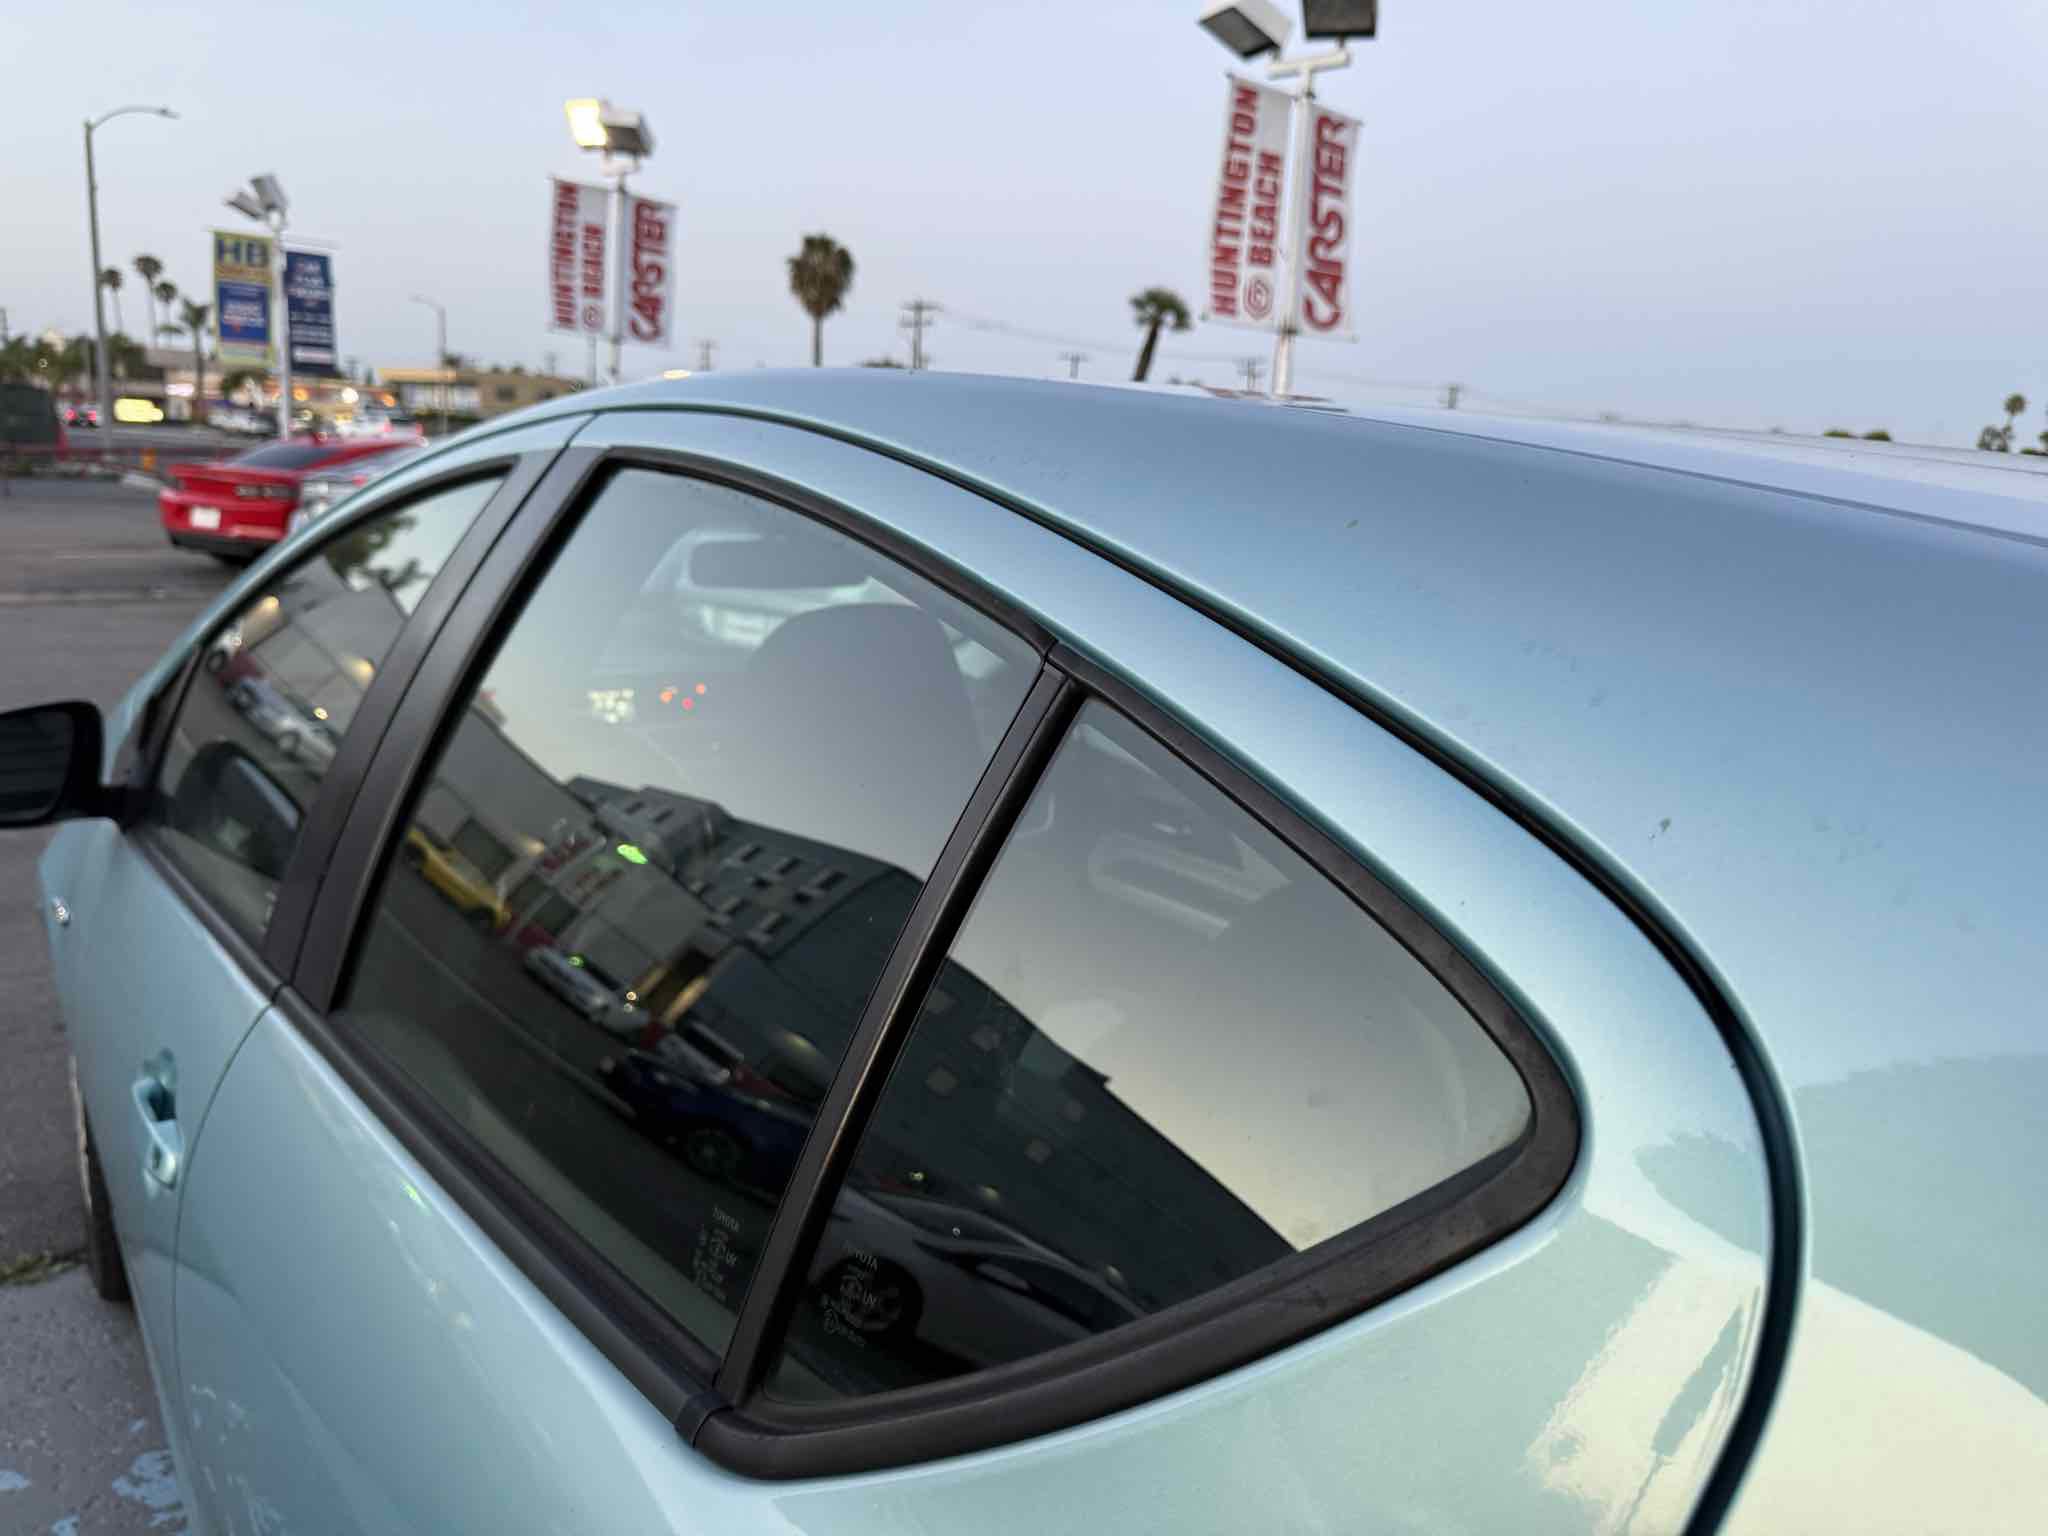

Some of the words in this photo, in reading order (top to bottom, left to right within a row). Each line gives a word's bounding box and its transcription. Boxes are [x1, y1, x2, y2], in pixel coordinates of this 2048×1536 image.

[630, 200, 666, 342] CARSTER
[1210, 86, 1258, 317] HUNTINGTON
[1247, 150, 1282, 268] BEACH
[1302, 114, 1347, 331] CARSTER
